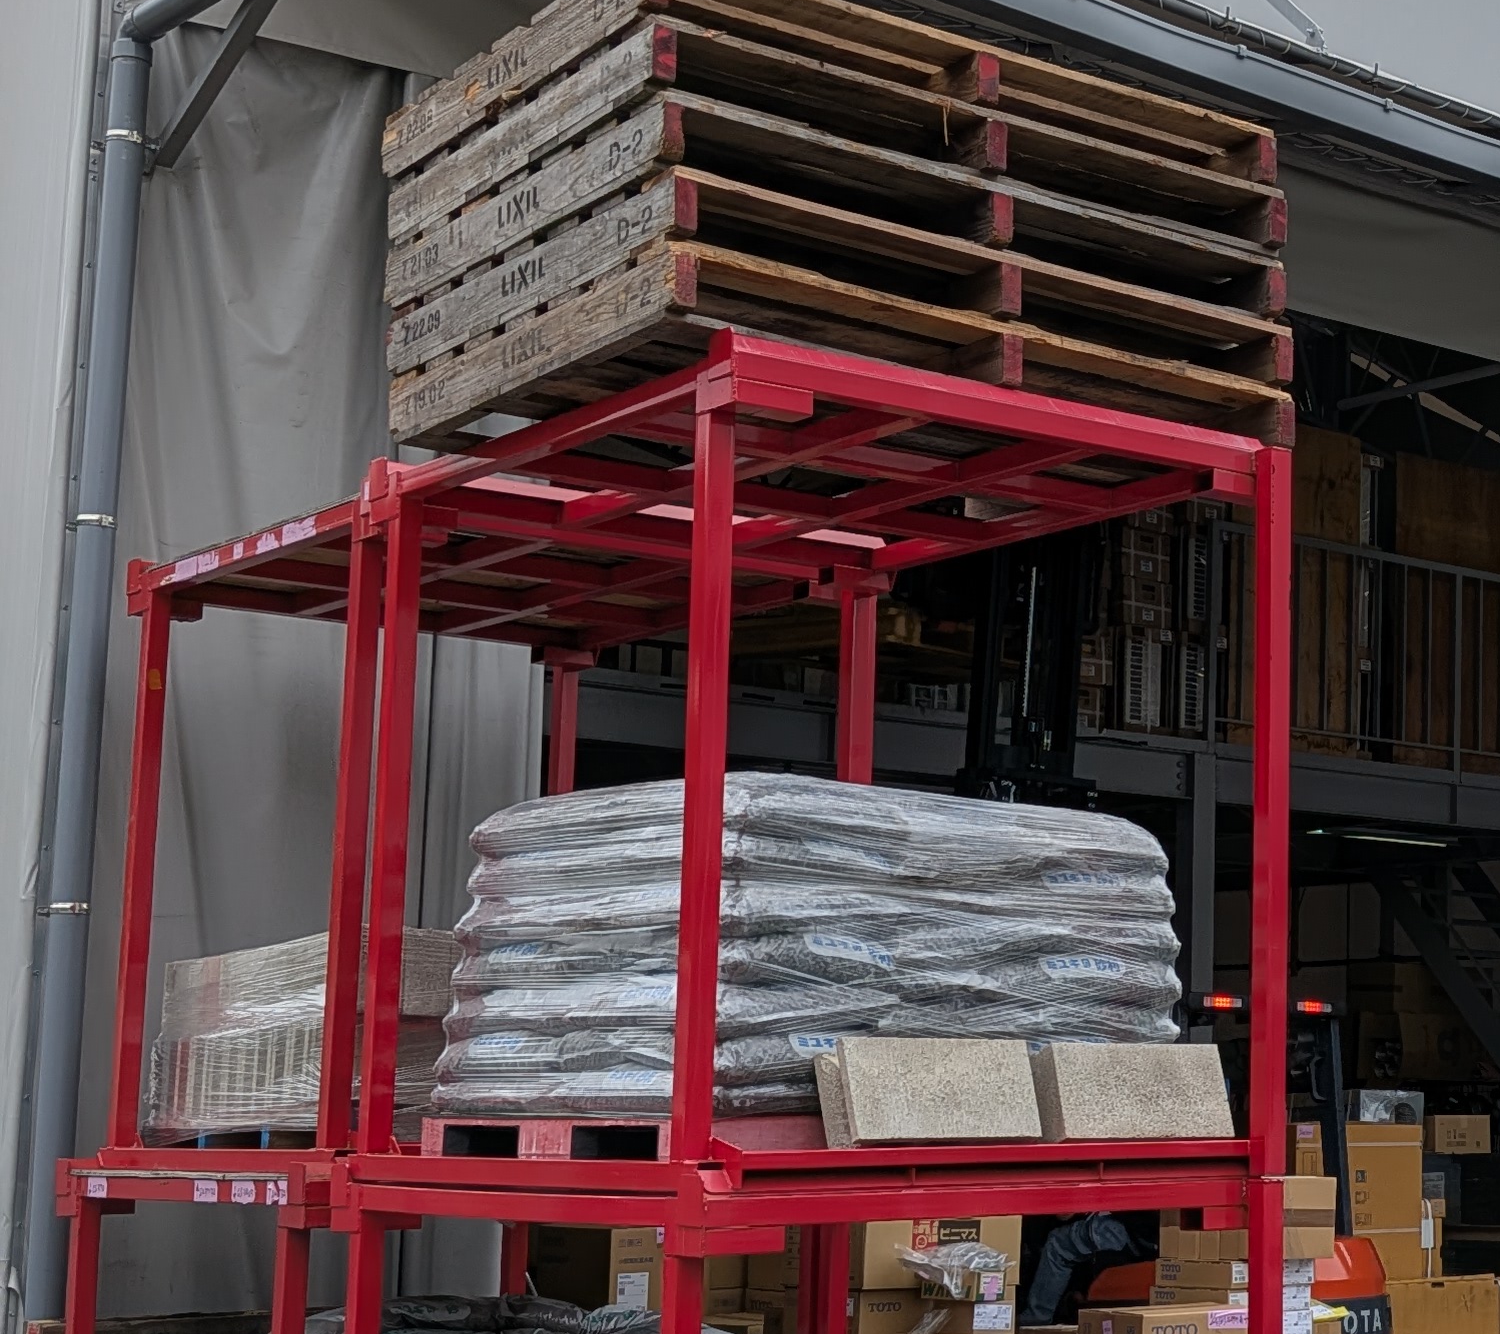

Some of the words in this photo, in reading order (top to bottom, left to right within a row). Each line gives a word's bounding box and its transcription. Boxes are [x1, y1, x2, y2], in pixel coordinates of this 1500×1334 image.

[488, 46, 527, 89] LIXIL
[498, 186, 540, 229] LIXIL
[617, 204, 653, 246] D-2
[501, 256, 546, 298] LIXIL
[1161, 1264, 1181, 1273] TOTO
[868, 1302, 901, 1312] TOTO
[1154, 1291, 1176, 1300] TOTO
